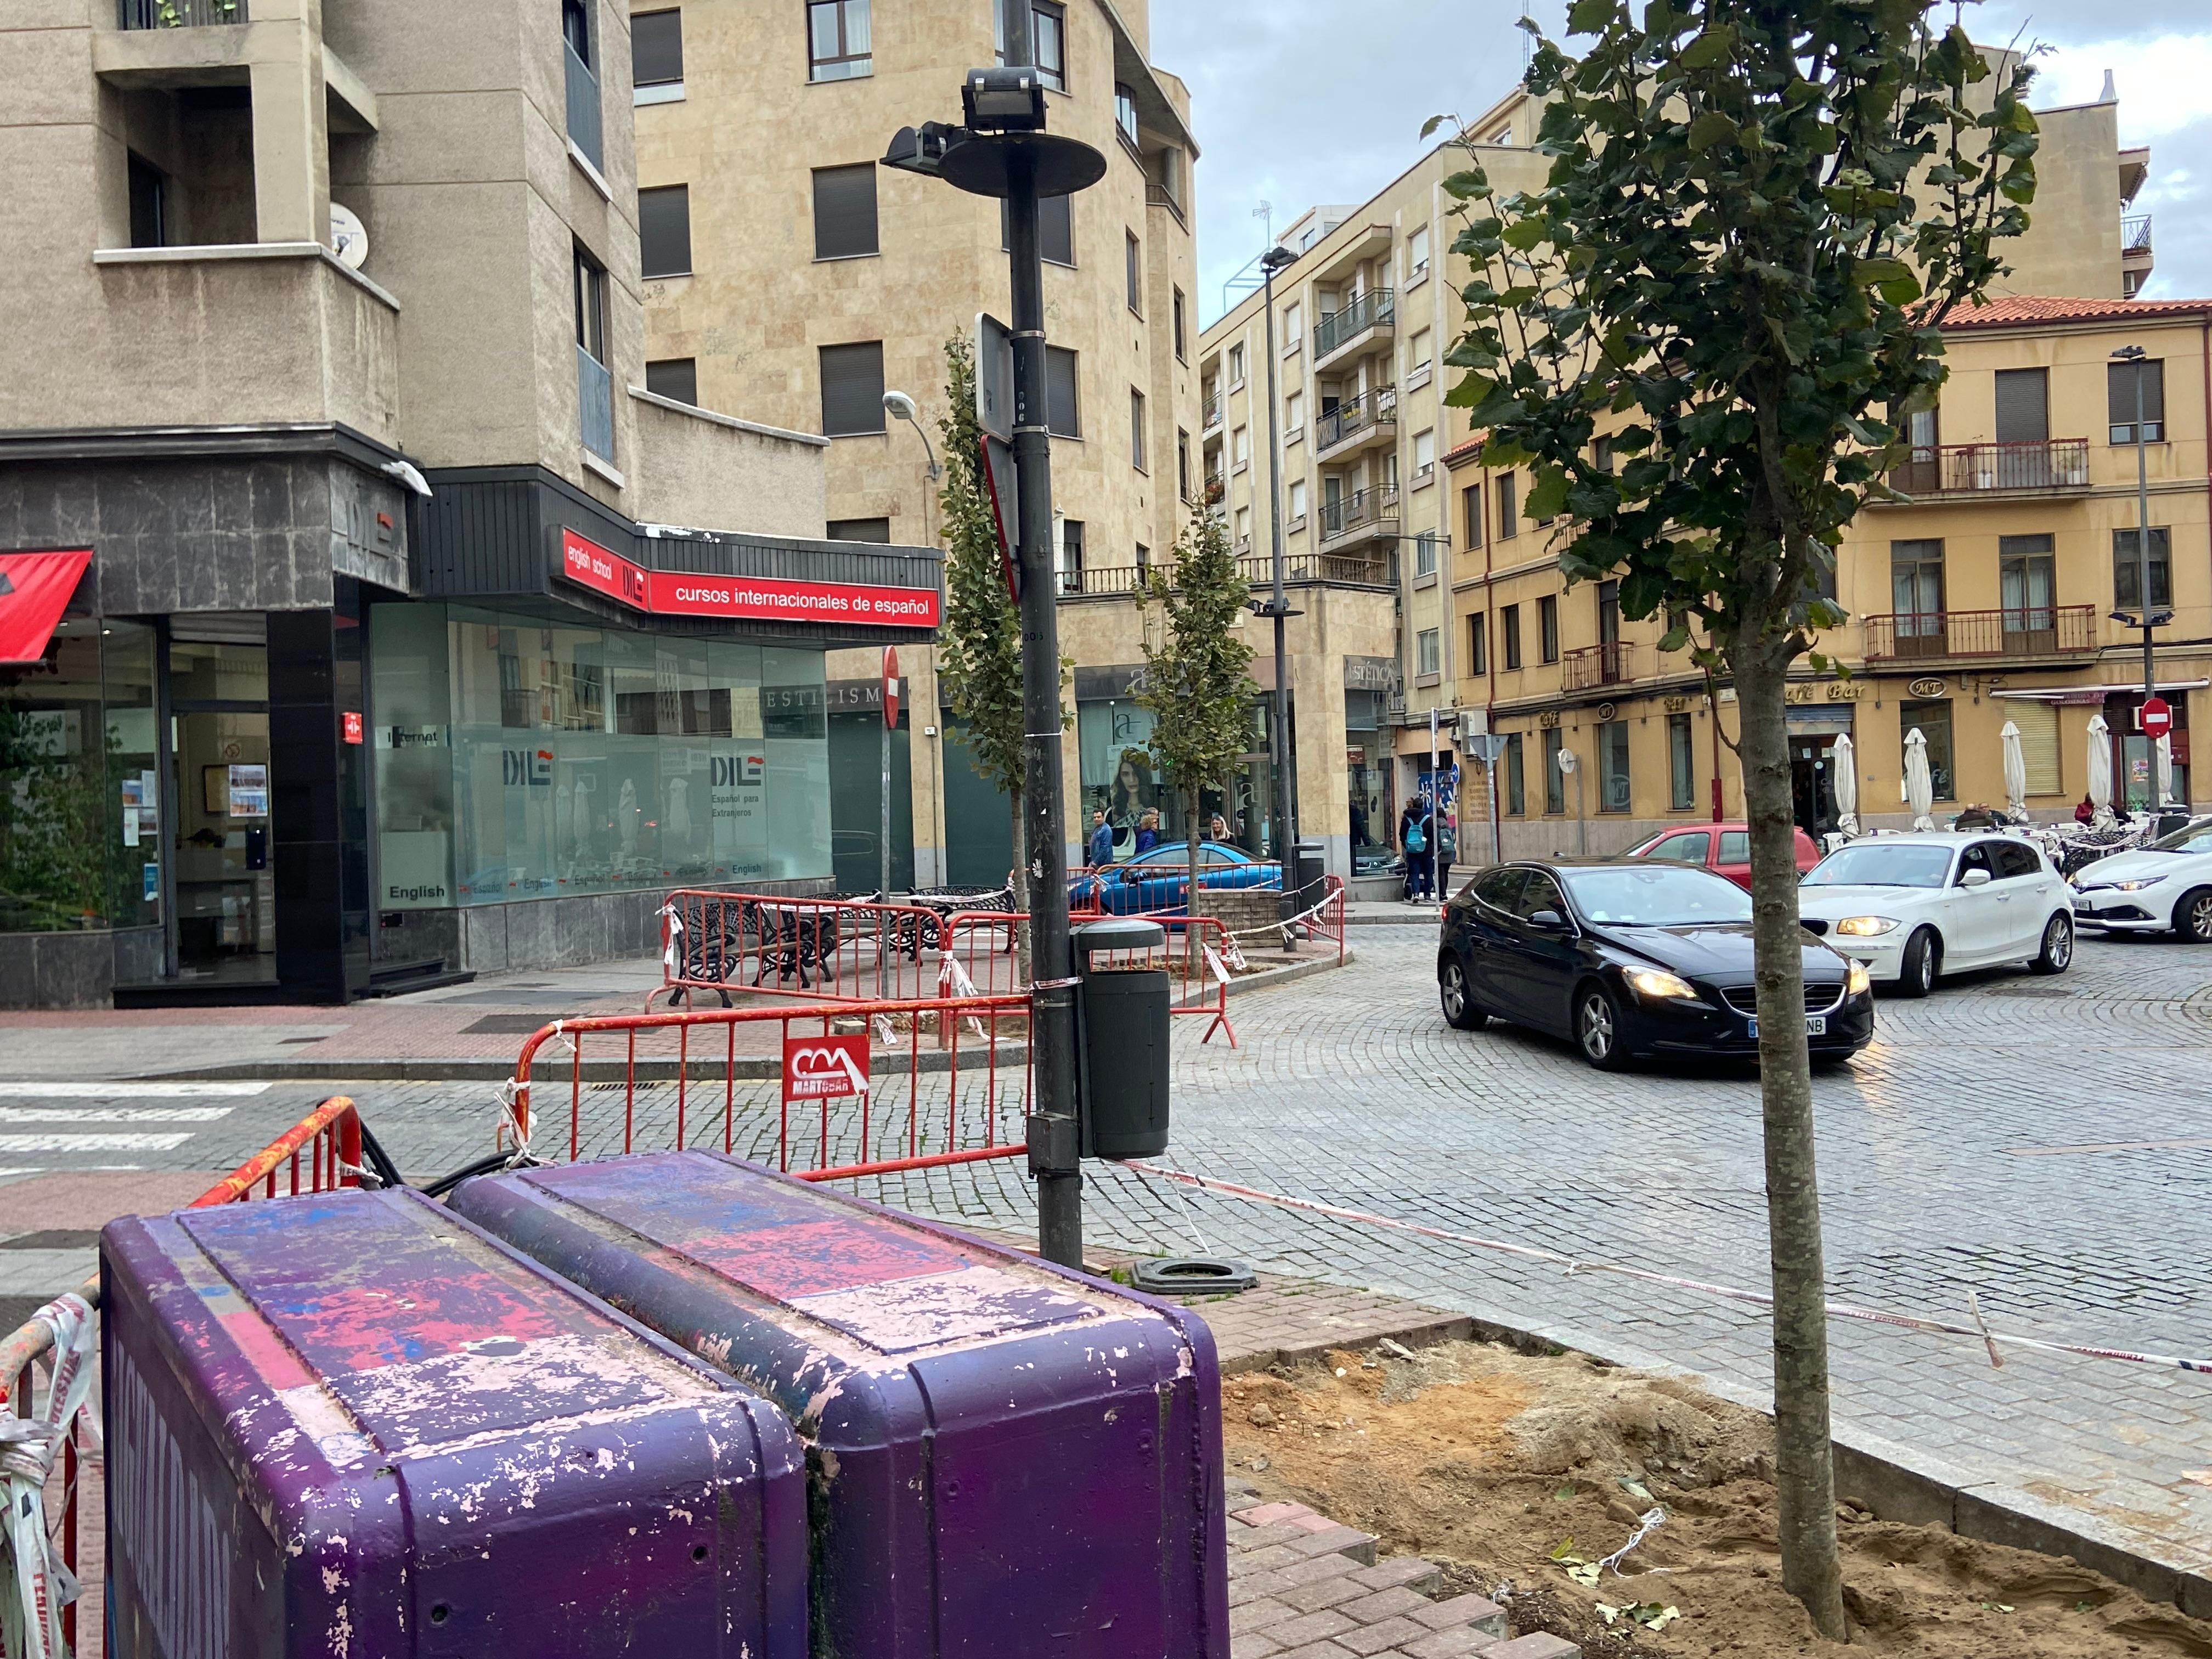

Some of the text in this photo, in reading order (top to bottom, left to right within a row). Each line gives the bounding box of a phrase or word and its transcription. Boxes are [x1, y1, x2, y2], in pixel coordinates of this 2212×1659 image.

[568, 545, 612, 581] english school
[675, 585, 929, 617] cursos internacionales de español
[1785, 683, 1865, 703] afé Bar
[1915, 681, 1941, 695] MT
[765, 687, 881, 708] ESTIISM
[387, 731, 438, 743] Iternet
[712, 794, 759, 805] Español para
[712, 809, 752, 819] Extranjeros
[732, 864, 762, 876] English
[524, 878, 552, 891] English
[389, 885, 445, 901] English
[1807, 1019, 1823, 1033] NB
